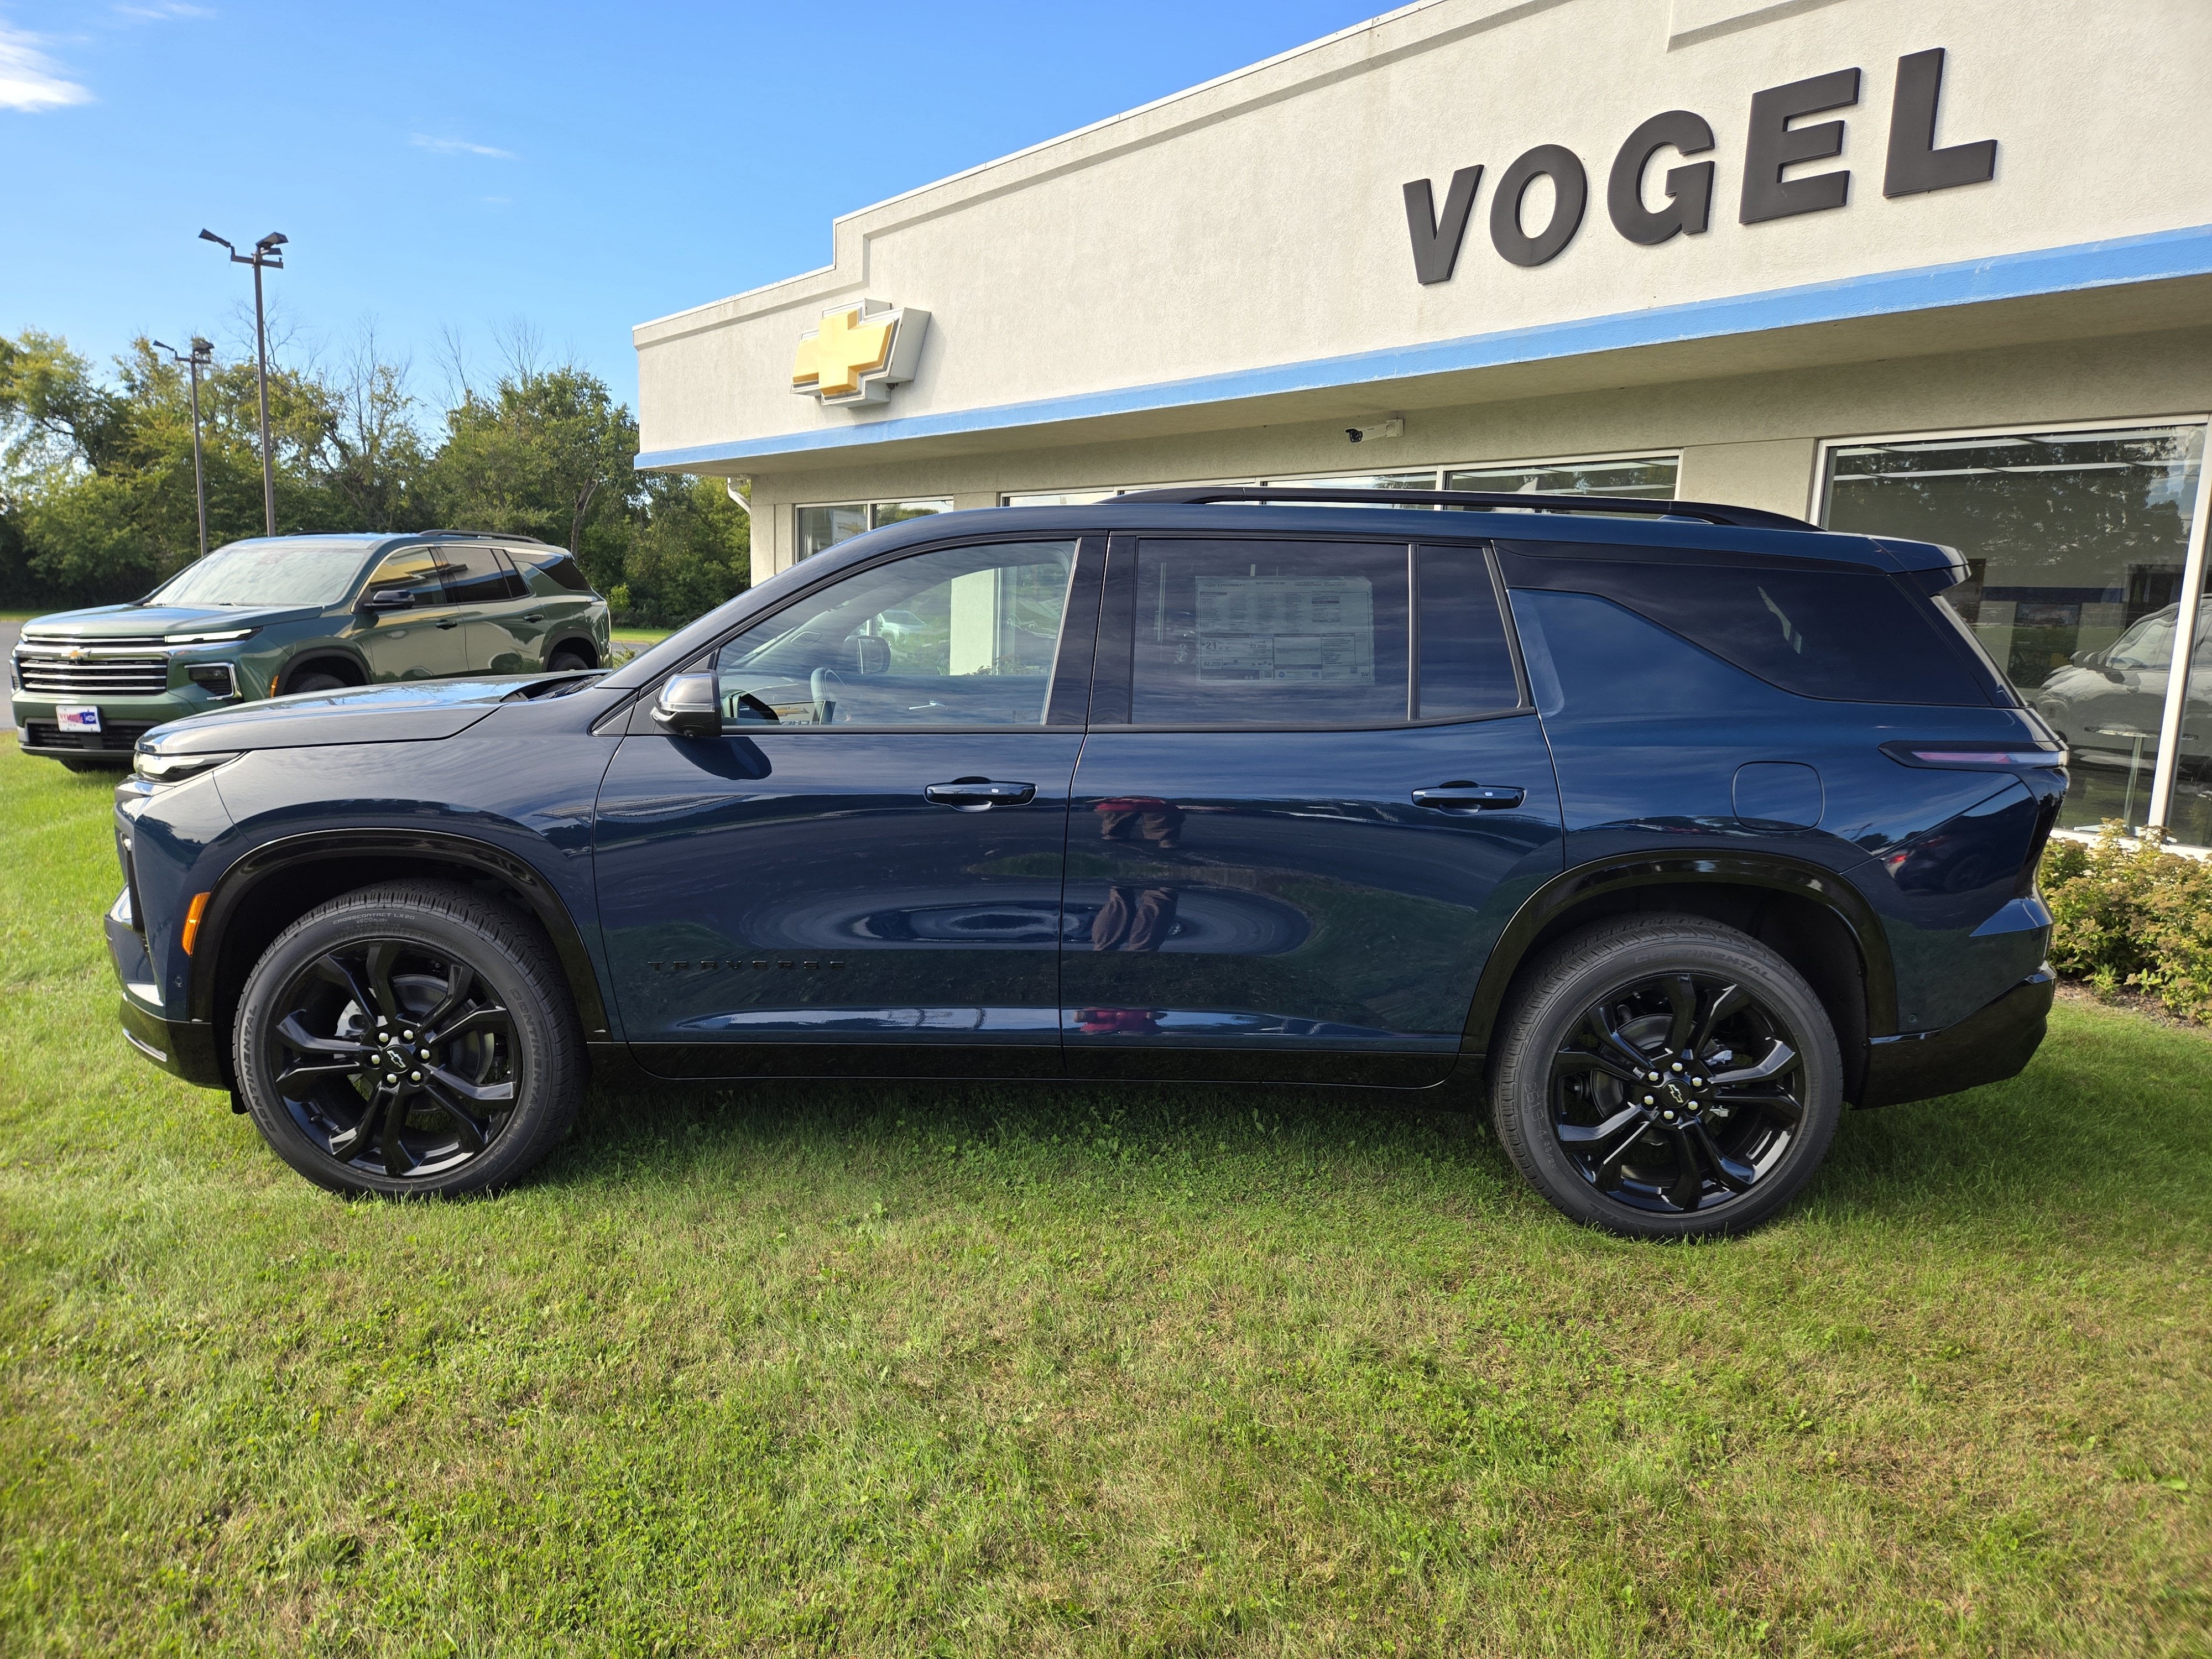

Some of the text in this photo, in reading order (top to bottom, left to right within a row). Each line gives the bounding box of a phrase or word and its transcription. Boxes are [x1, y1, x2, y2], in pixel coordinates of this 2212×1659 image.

[1402, 47, 1997, 285] VOGEL
[647, 961, 845, 971] TRAVERSE
[1634, 949, 1771, 978] CONTINENTAL
[243, 1005, 277, 1133] CONTINENTAL
[510, 988, 541, 1115] CONTINENTAL
